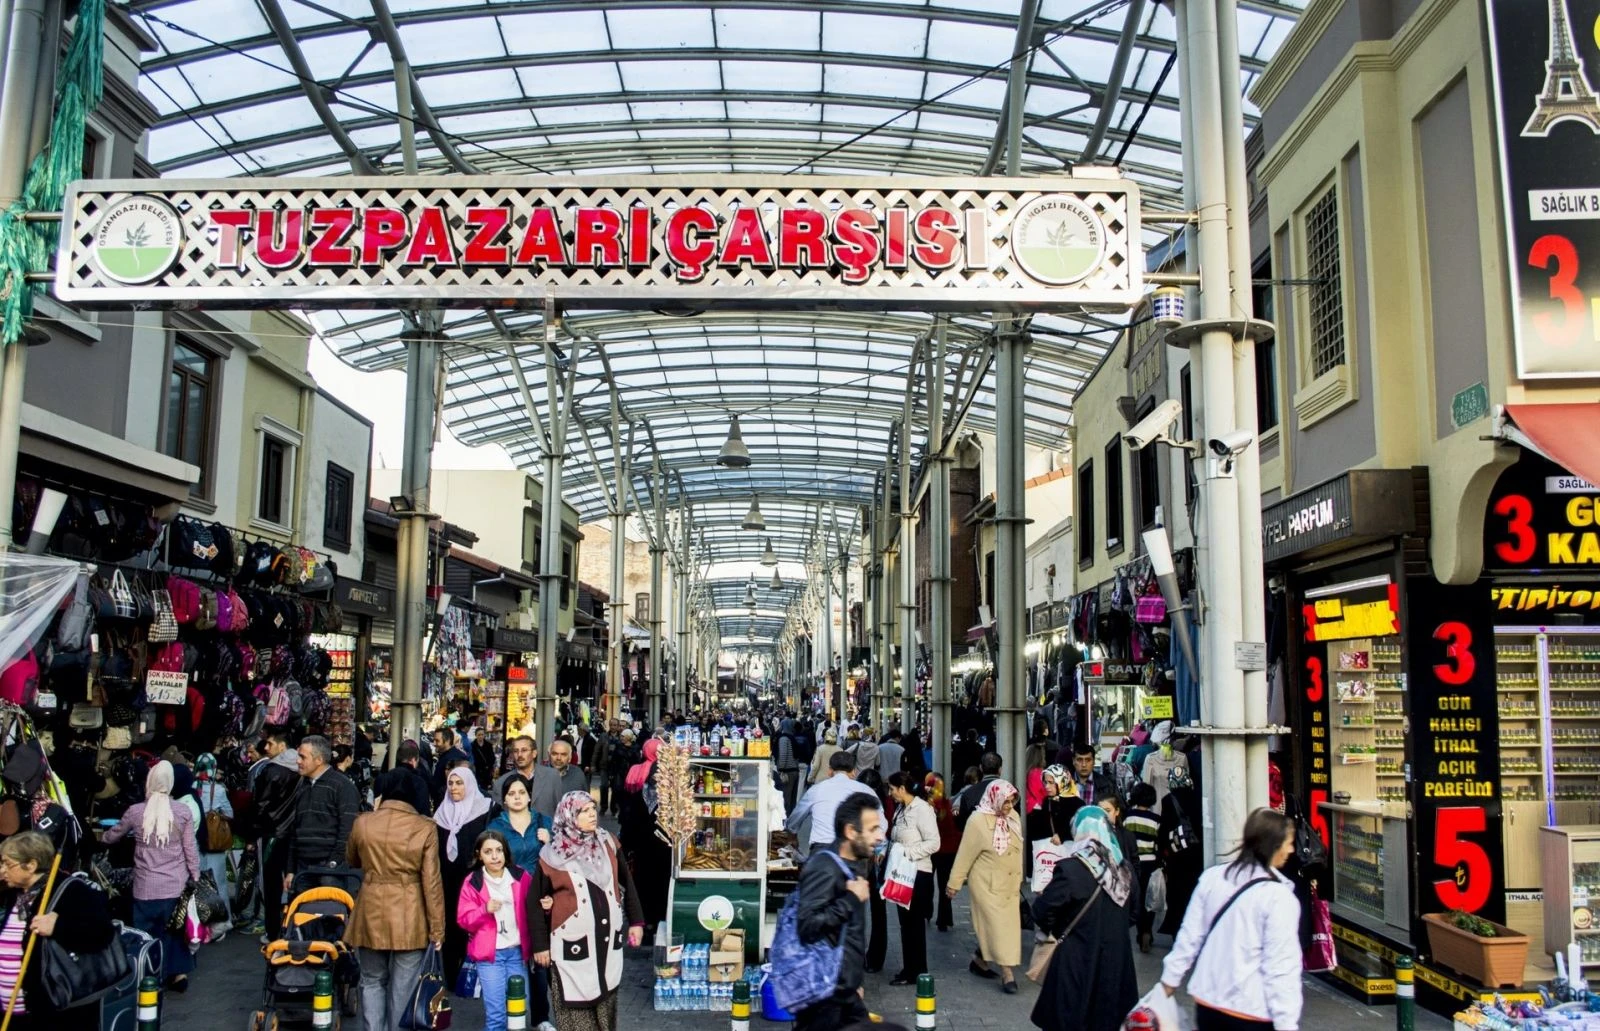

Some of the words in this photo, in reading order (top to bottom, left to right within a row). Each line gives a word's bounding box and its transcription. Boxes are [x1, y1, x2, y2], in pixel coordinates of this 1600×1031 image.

[1541, 192, 1588, 214] SAĞLIK
[1528, 233, 1586, 346] 3
[1287, 497, 1335, 539] PARFÜM
[1494, 494, 1537, 563] 3
[1566, 496, 1600, 527] G
[1433, 621, 1476, 685] 3
[1306, 656, 1323, 701] 3
[1438, 693, 1471, 710] GÜN
[1434, 736, 1480, 752] İTHAL
[1424, 778, 1493, 797] PARFÜM
[1438, 760, 1477, 777] AÇIK
[1433, 806, 1493, 914] 5
